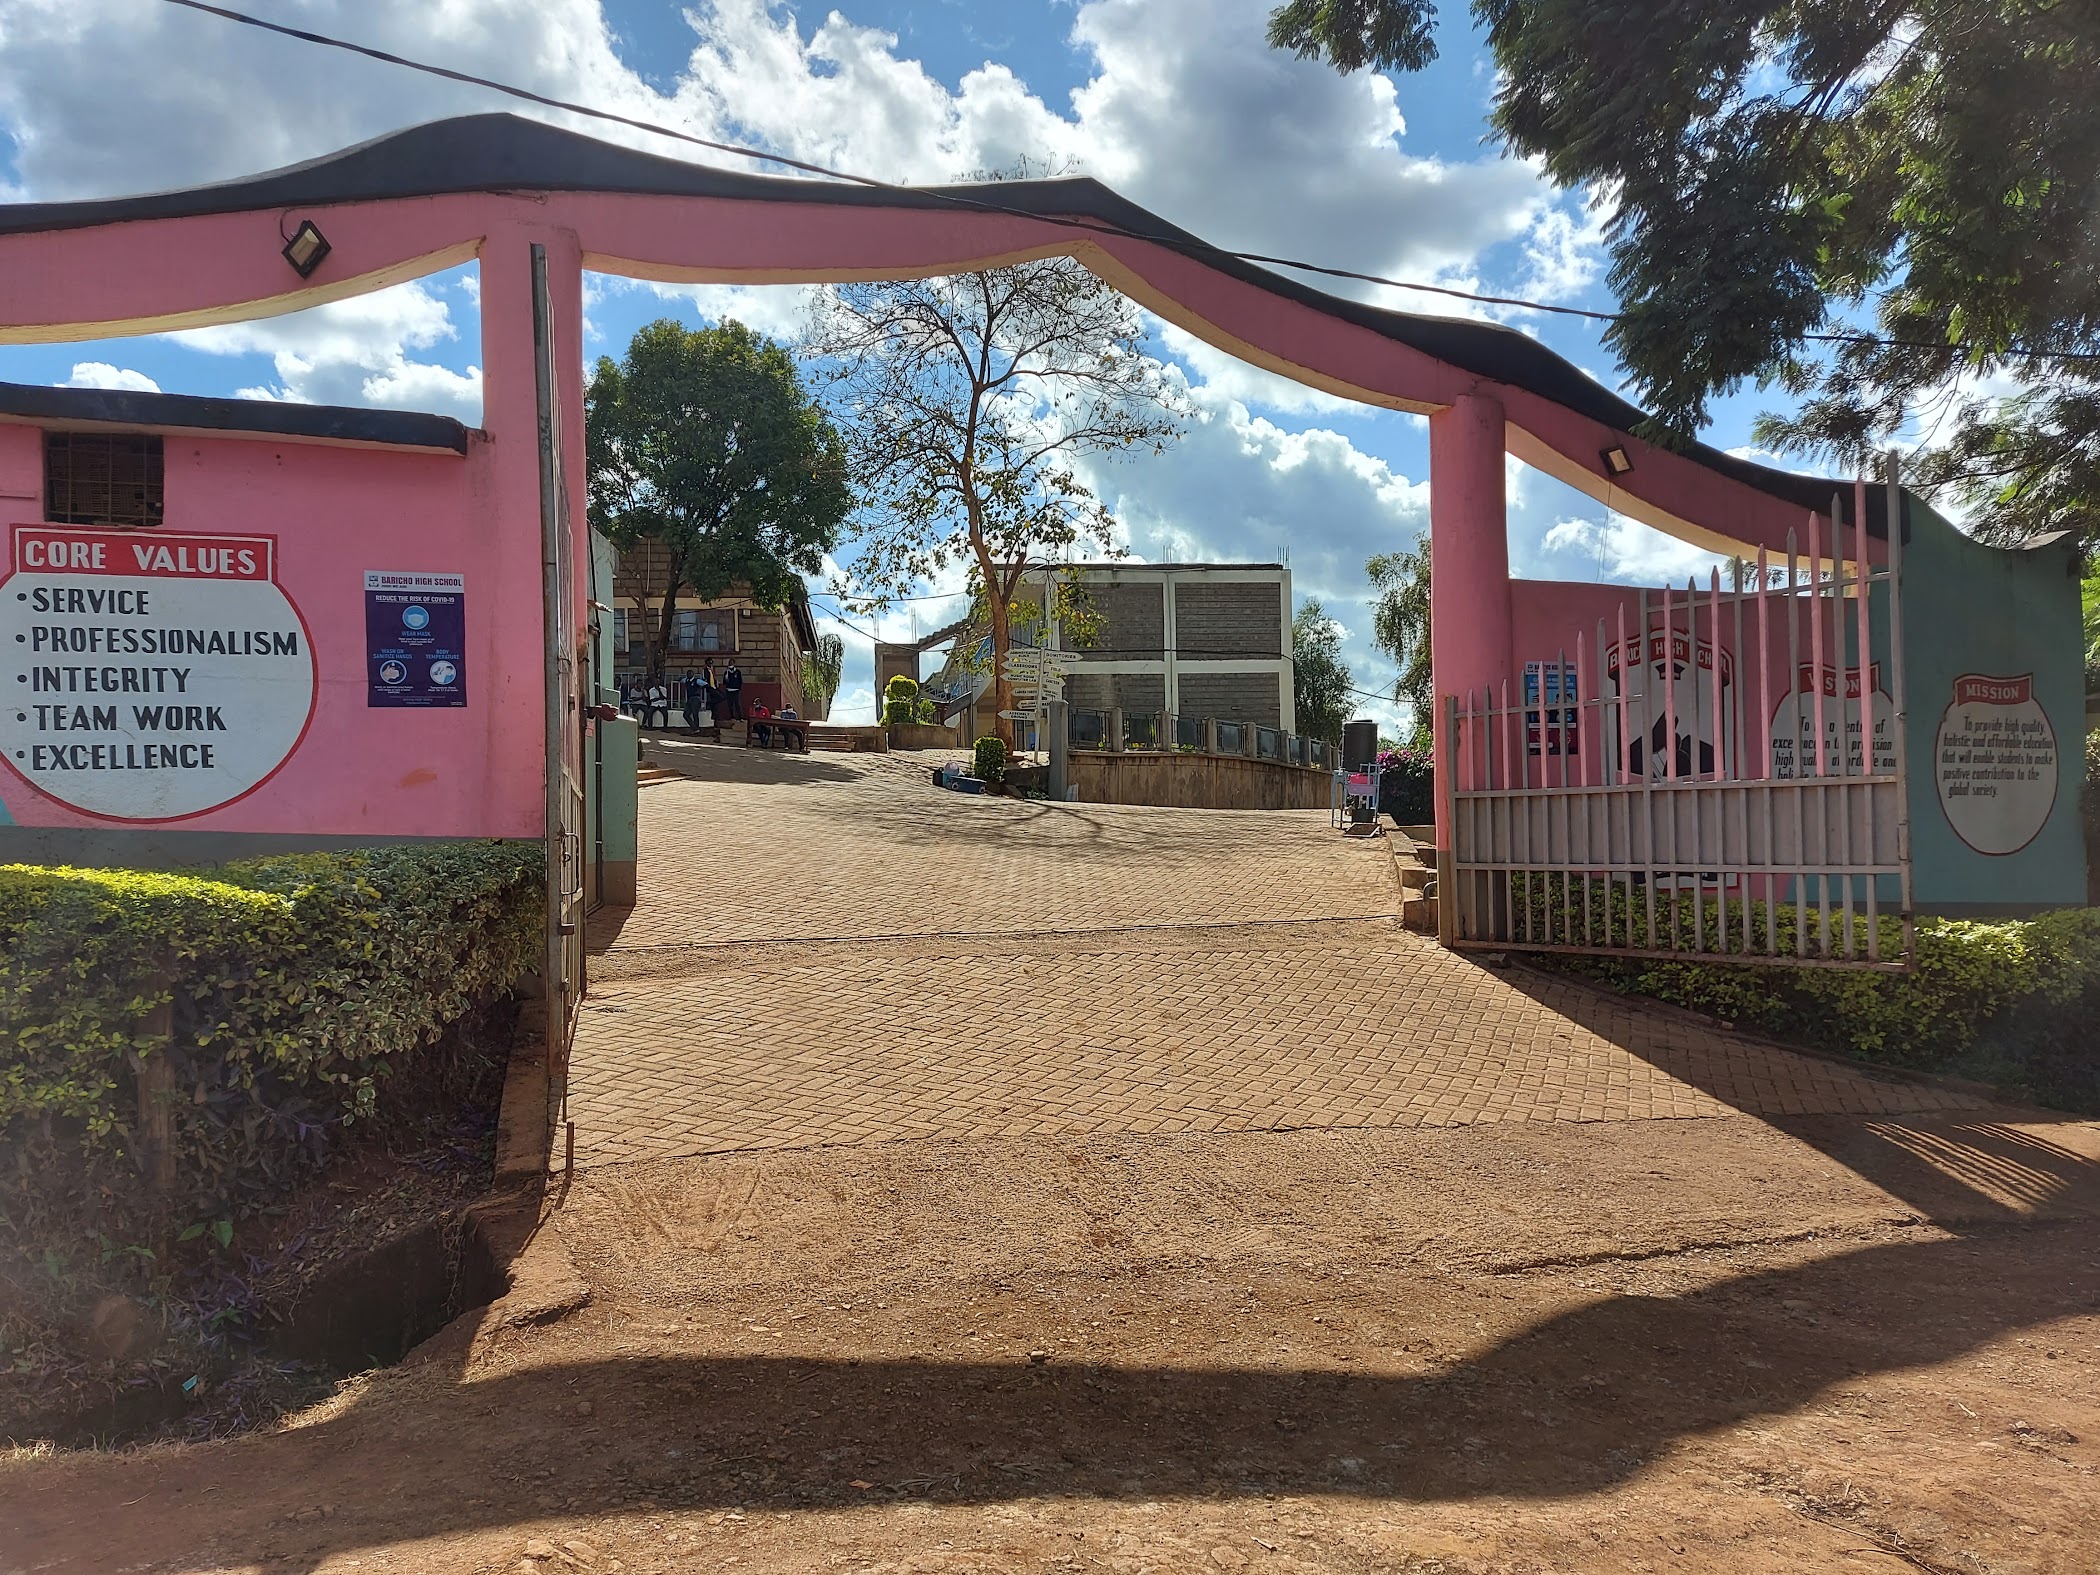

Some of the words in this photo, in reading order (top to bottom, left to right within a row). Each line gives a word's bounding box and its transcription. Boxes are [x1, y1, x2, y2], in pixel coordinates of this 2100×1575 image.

[25, 540, 107, 570] CORE
[132, 544, 257, 575] VALUES
[381, 576, 412, 584] BARICHO
[415, 577, 432, 586] HIGH
[434, 578, 462, 586] SCHOOL
[32, 587, 150, 616] SERVICE
[376, 594, 397, 602] REDUCE
[31, 626, 298, 656] PROFESSIONALISM
[32, 666, 191, 693] INTEGRITY
[1966, 684, 2019, 699] MISSION
[32, 704, 117, 731] TEAM
[132, 705, 227, 731] WORK
[1875, 718, 1886, 734] of
[1964, 716, 1973, 731] To
[1975, 717, 2003, 733] provide
[2005, 717, 2020, 734] high
[1943, 732, 1971, 747] holistic
[1972, 733, 1985, 747] and
[1987, 733, 2022, 749] affordable
[2024, 736, 2054, 750] education
[31, 744, 215, 771] EXCELLENCE
[1775, 751, 1794, 768] high
[1942, 749, 1956, 764] that
[1958, 749, 1972, 764] will
[1973, 750, 1994, 764] enable
[1997, 751, 2024, 765] students
[2025, 752, 2033, 765] to
[2034, 751, 2053, 765] make
[1943, 766, 1970, 782] positive
[1972, 766, 2015, 781] contribution
[2017, 767, 2025, 781] to
[2028, 766, 2040, 781] the
[1948, 782, 1970, 799] global
